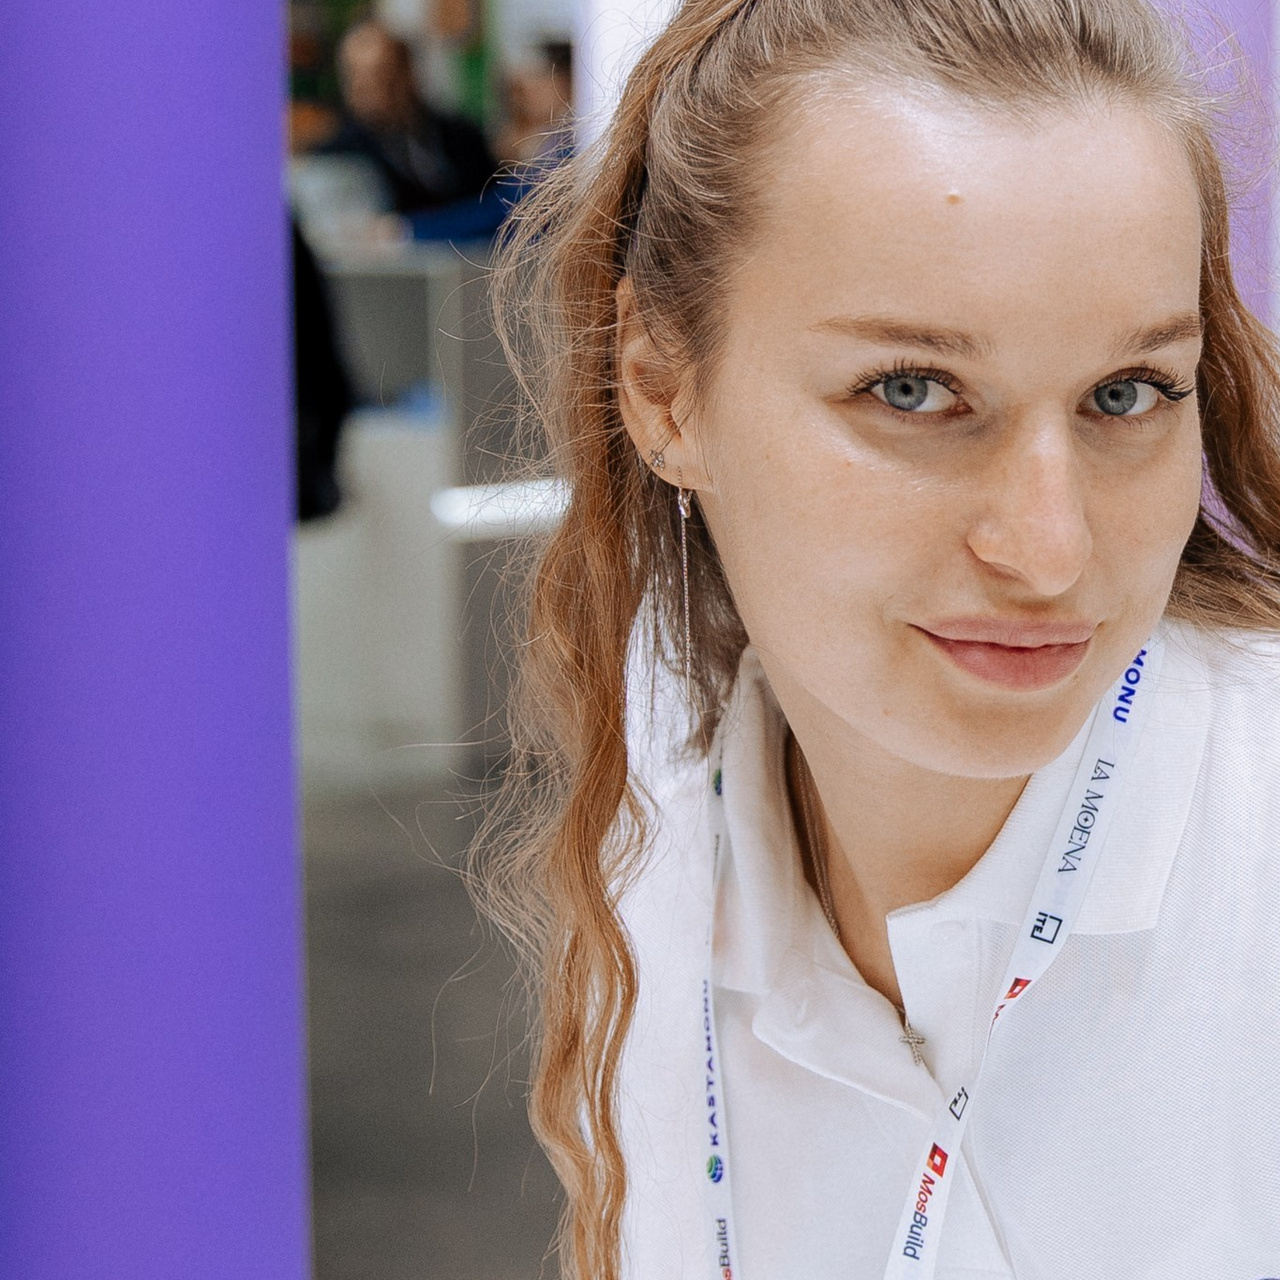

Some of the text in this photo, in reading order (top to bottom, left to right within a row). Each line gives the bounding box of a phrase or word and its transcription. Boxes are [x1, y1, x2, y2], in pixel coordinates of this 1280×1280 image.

[1057, 788, 1105, 874] MOENA
[703, 978, 720, 1147] KASTAMONU
[903, 1172, 935, 1261] MosBuild
